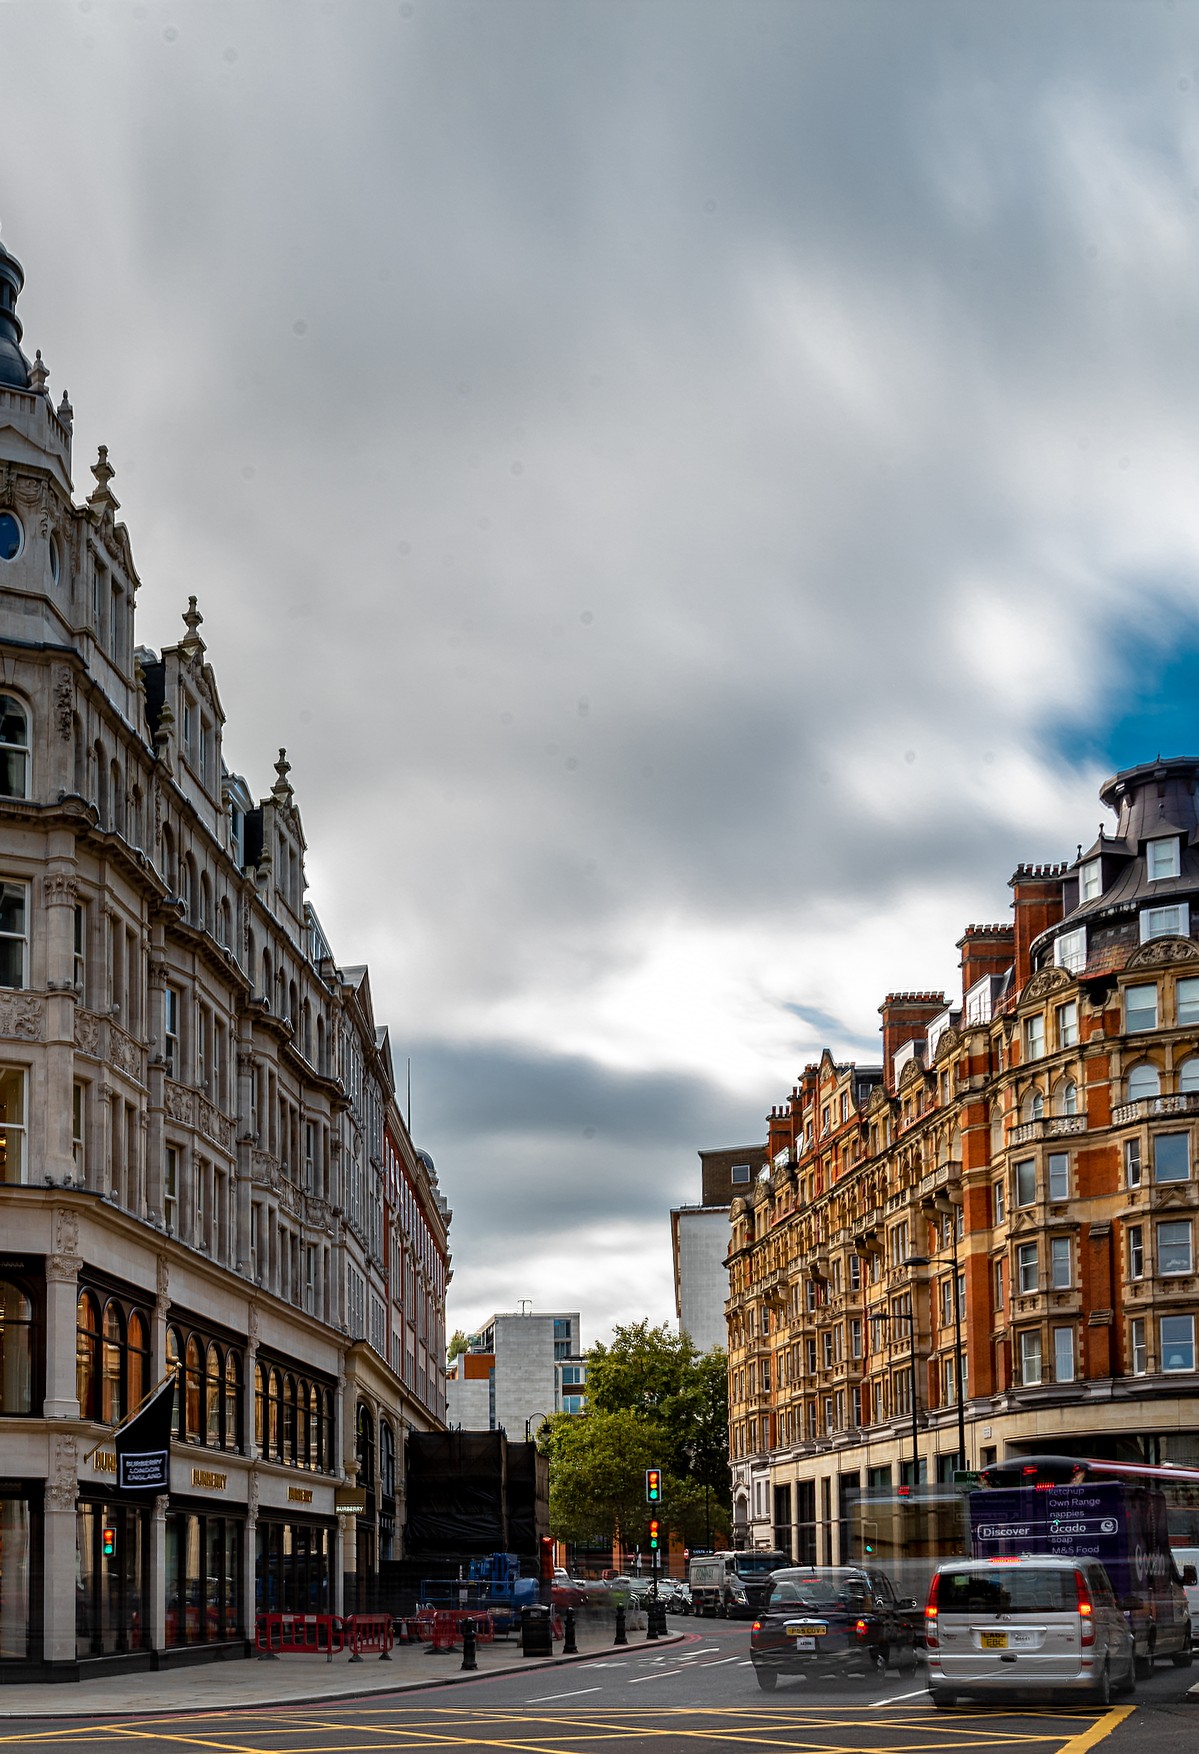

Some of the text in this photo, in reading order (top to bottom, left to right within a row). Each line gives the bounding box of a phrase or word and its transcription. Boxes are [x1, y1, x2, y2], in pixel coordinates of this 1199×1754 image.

[125, 1459, 162, 1467] BURBERRY
[129, 1466, 160, 1474] LONDON
[1049, 1498, 1101, 1507] Own Range
[336, 1505, 363, 1513] BURBERRY
[1049, 1510, 1085, 1519] nappies
[983, 1524, 1086, 1538] Discover Ocado
[1051, 1536, 1073, 1544] soap
[1052, 1545, 1100, 1554] M&S Food
